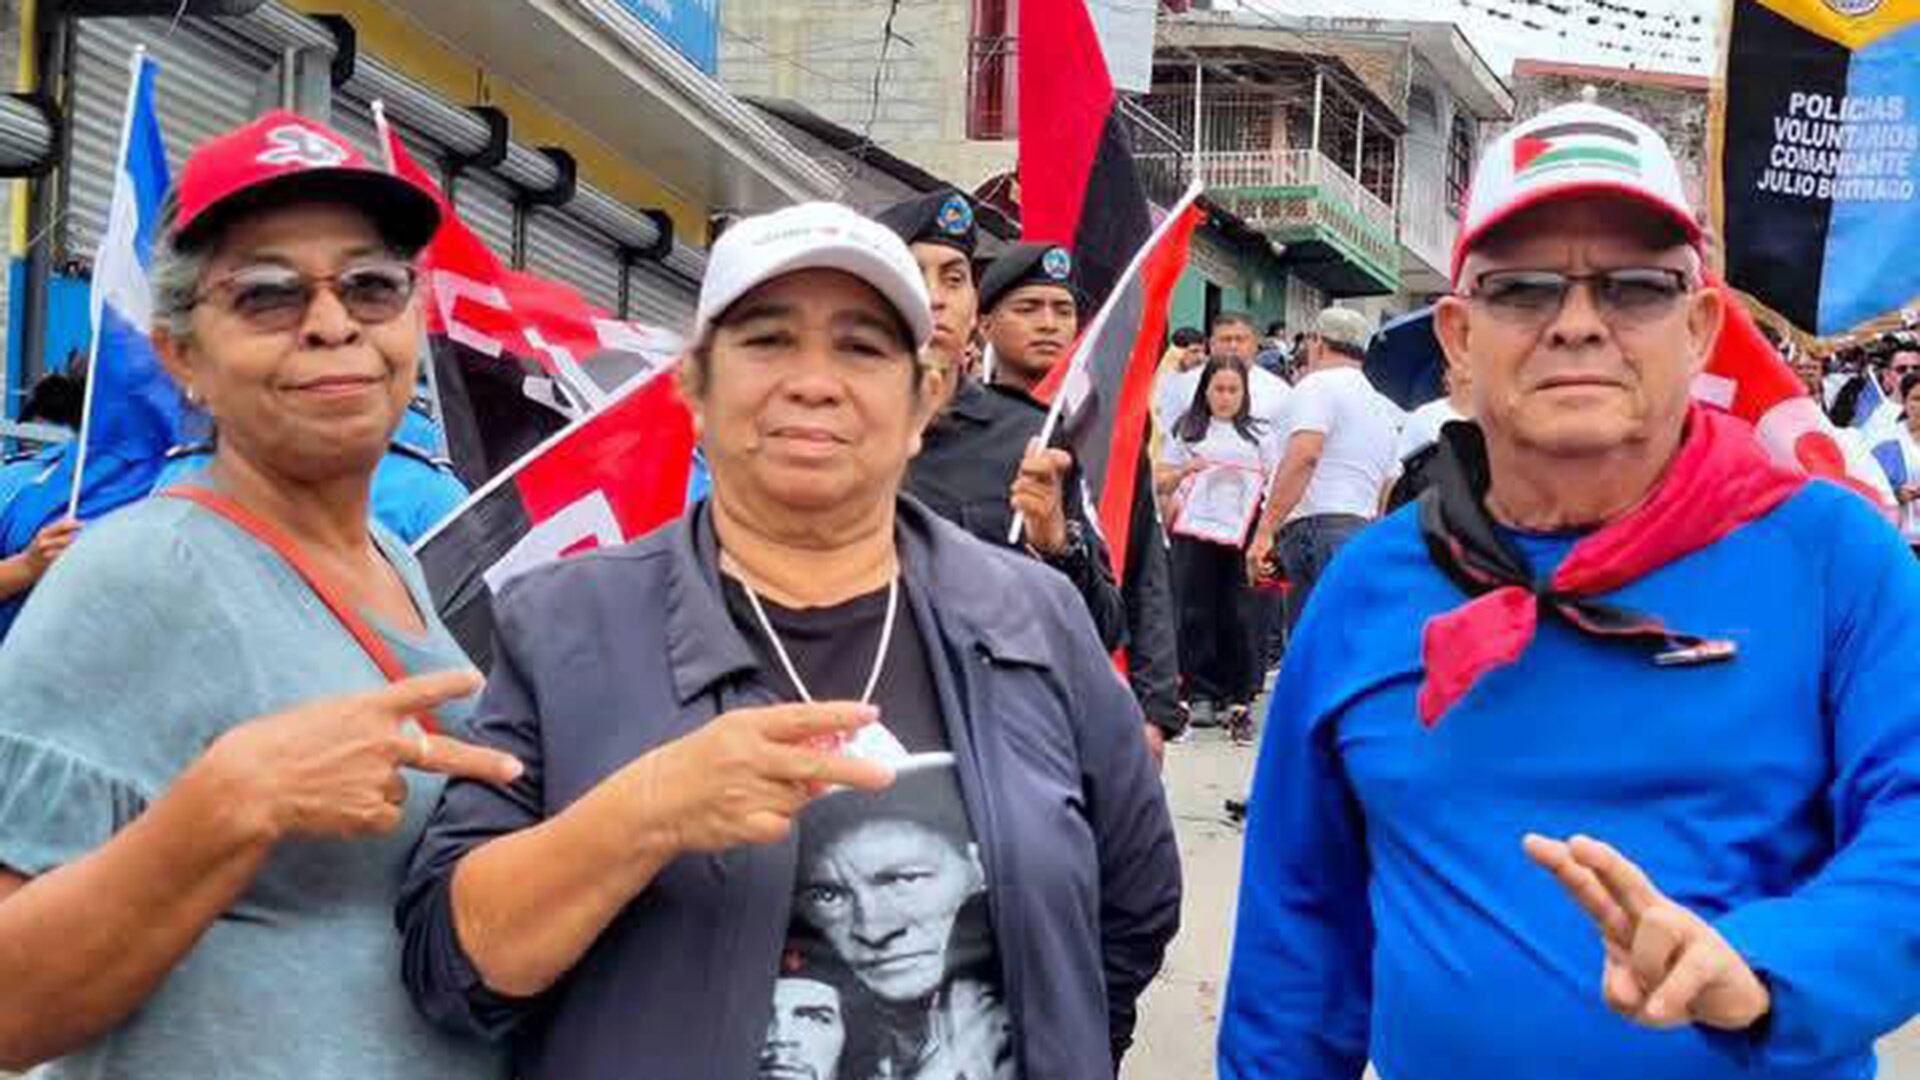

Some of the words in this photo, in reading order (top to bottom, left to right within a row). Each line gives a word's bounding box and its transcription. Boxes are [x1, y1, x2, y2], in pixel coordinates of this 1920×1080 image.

[1789, 92, 1904, 121] POLICIAS
[1771, 144, 1913, 175] COMANDANTE
[1757, 169, 1815, 196] JULIO
